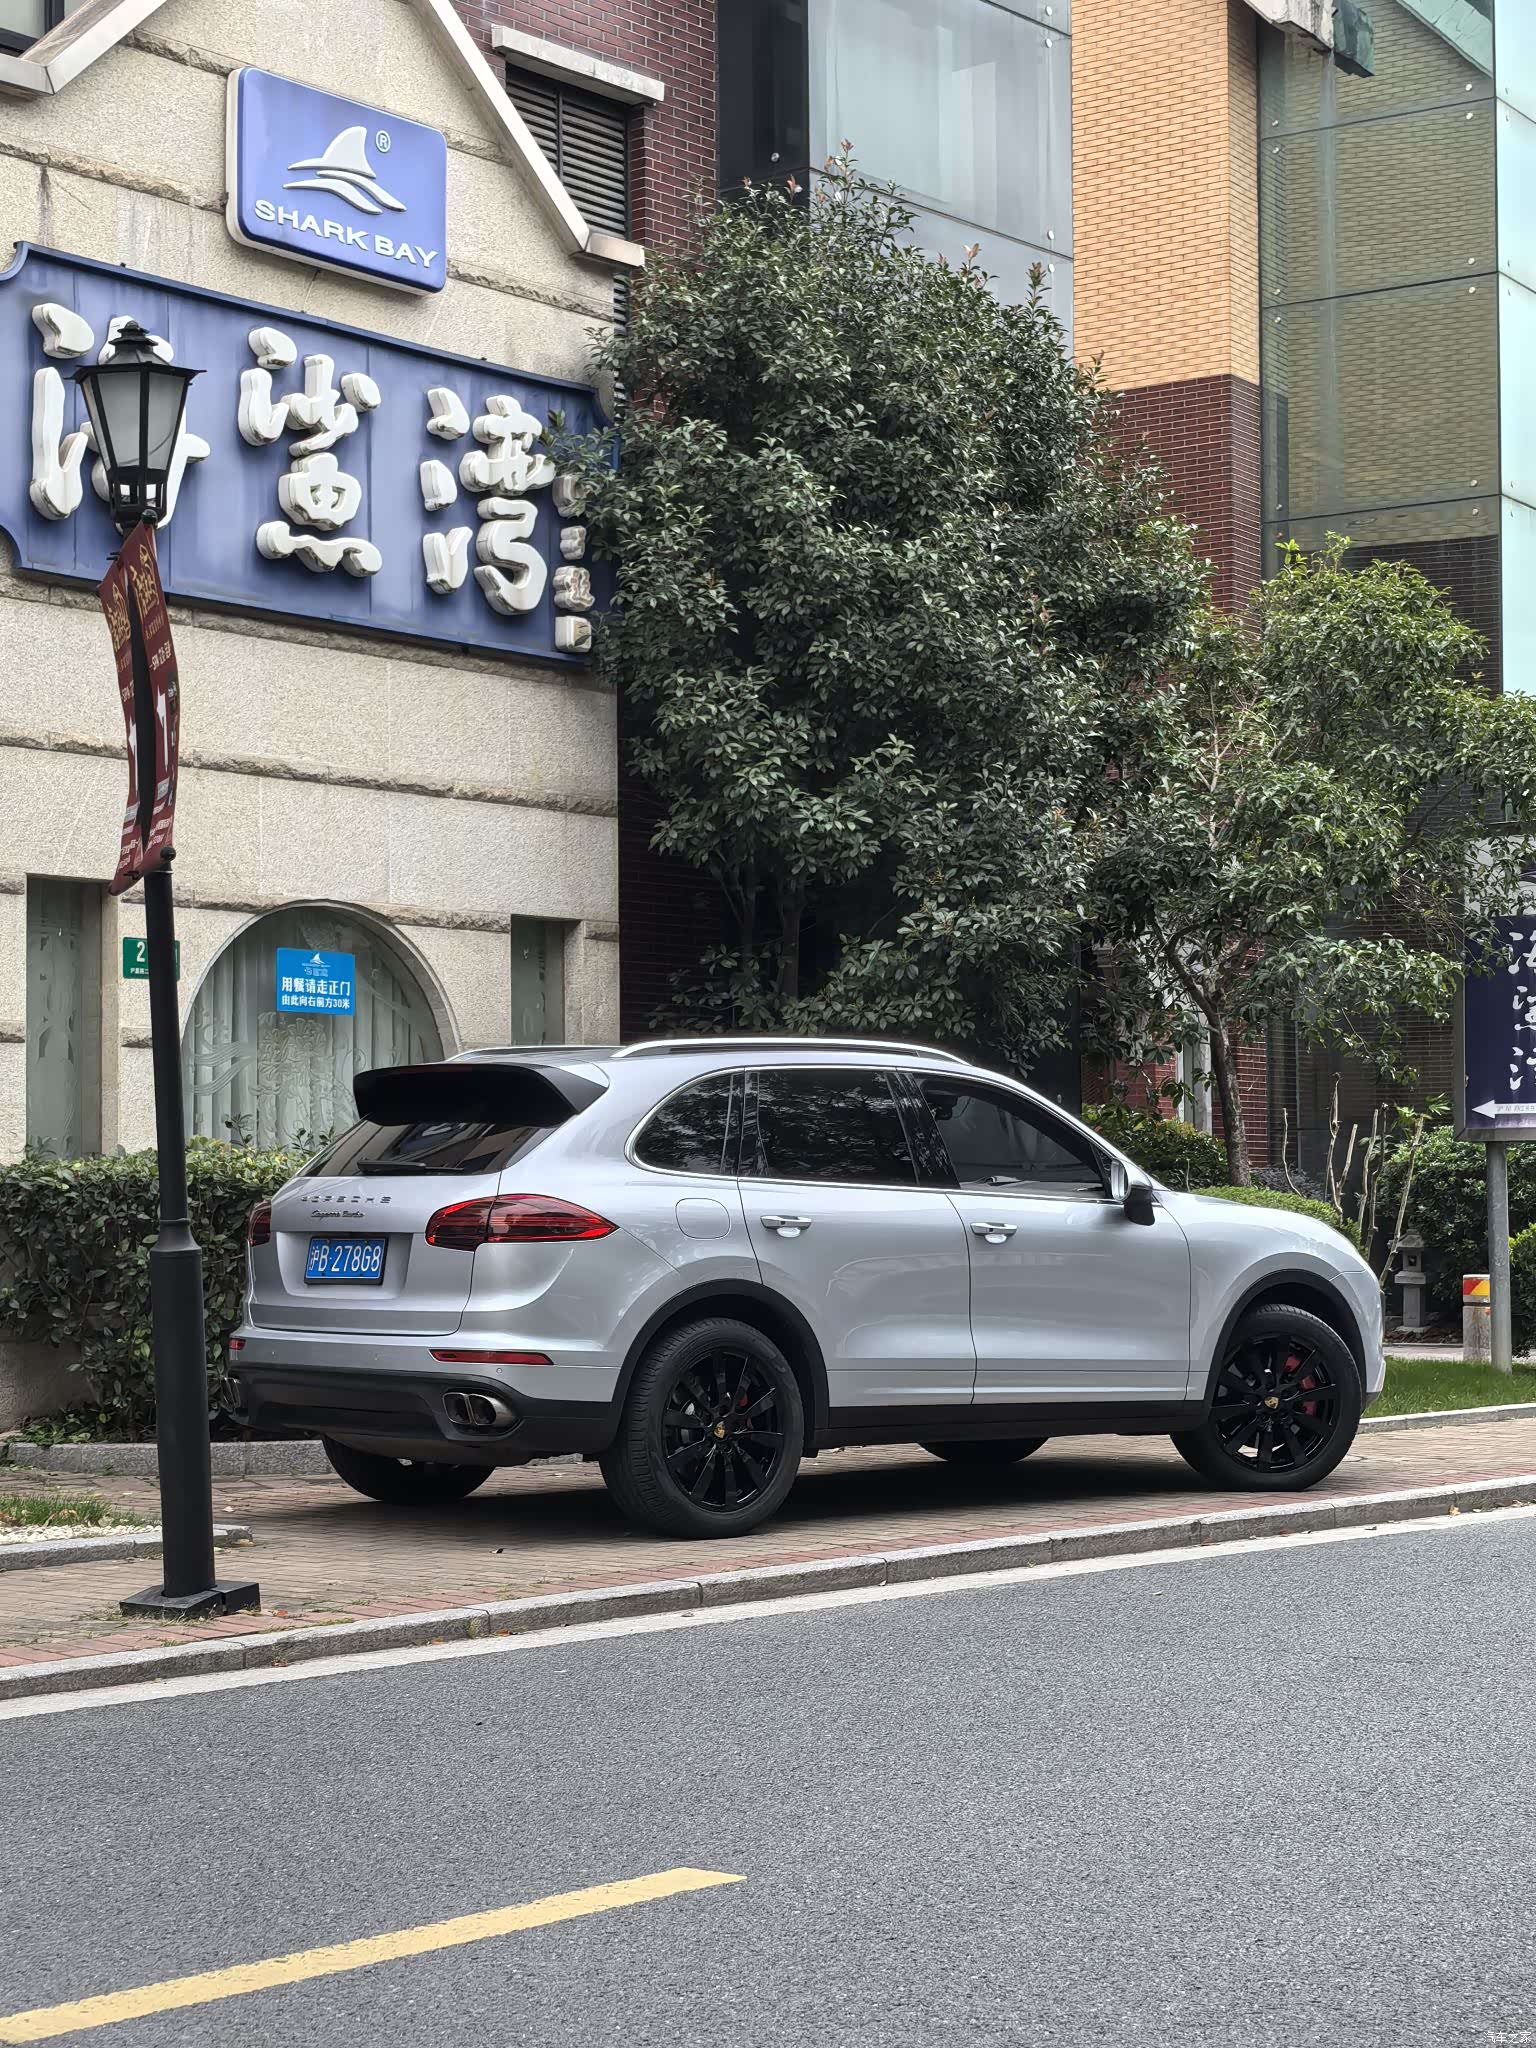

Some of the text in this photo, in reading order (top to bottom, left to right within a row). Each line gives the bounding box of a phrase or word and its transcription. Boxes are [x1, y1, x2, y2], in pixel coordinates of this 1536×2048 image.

[254, 199, 438, 269] SHARK BAY
[281, 976, 351, 996] 用餐请走正门
[281, 994, 351, 1010] 由此向右前方30米
